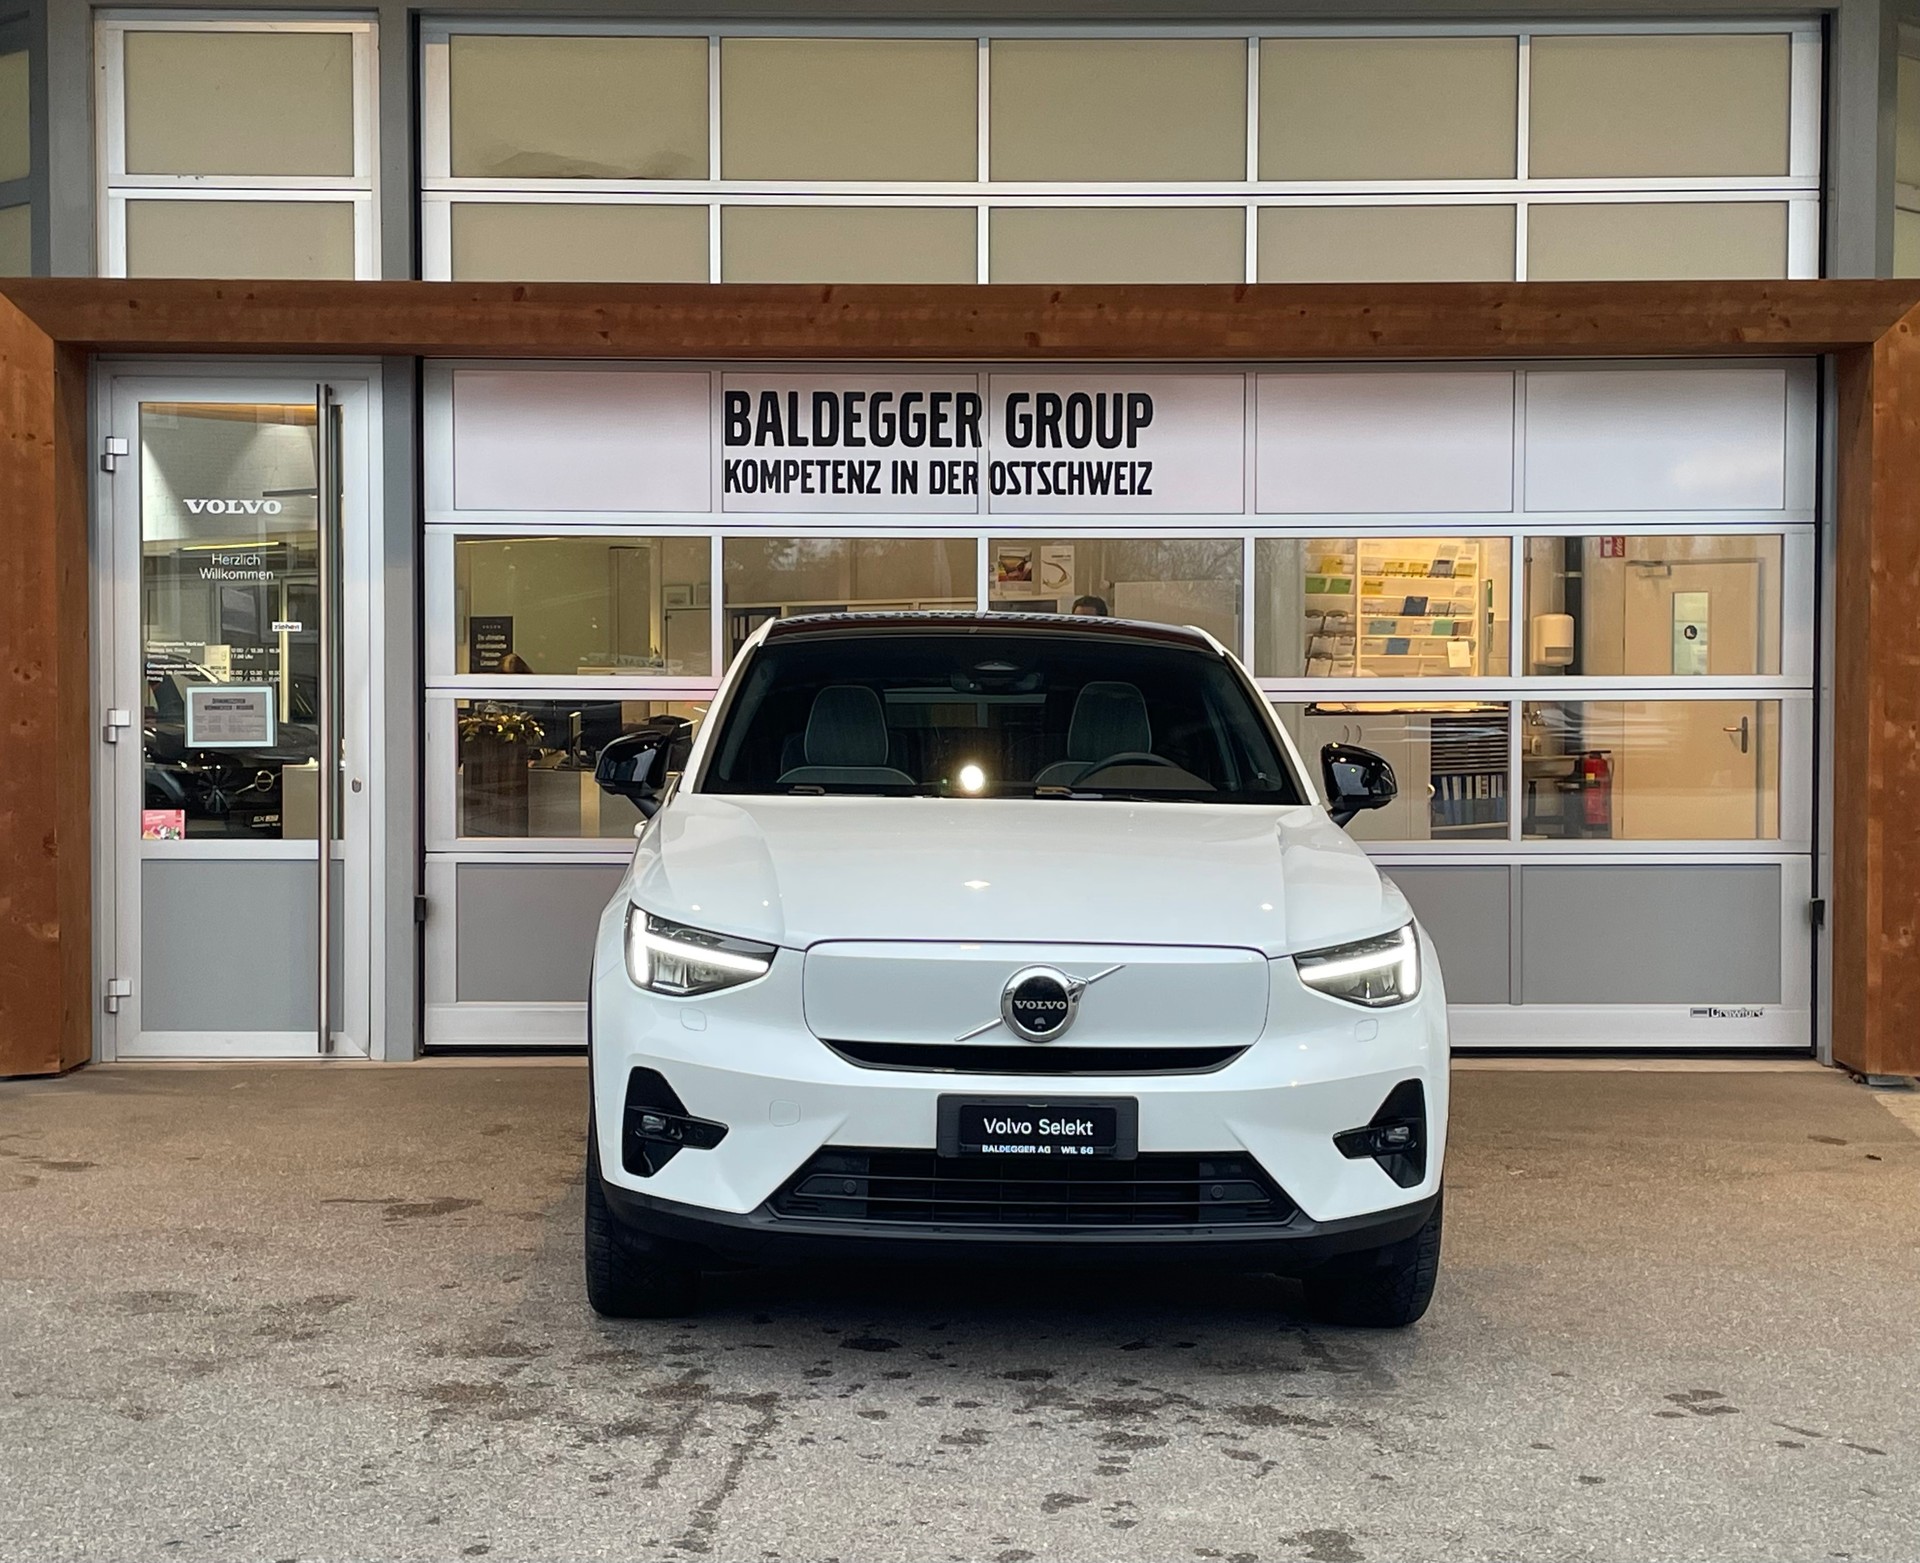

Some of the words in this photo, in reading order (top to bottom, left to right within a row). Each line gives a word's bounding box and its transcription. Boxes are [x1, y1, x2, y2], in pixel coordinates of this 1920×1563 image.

[724, 391, 982, 448] BALDEGGER
[1005, 392, 1153, 449] GROUP
[724, 459, 881, 495] KOMPETENZ
[892, 460, 918, 495] IN
[929, 460, 978, 495] DER
[989, 461, 1153, 496] OSTSCHWEIZ
[183, 499, 282, 514] VOLVO
[211, 553, 260, 565] Herzlich
[199, 567, 274, 580] Willkommen
[1014, 1000, 1067, 1010] VOLVO
[983, 1117, 1033, 1135] Volvo
[1038, 1118, 1094, 1136] Selekt
[982, 1144, 1036, 1154] BALDEGGER
[1037, 1145, 1052, 1154] AG
[1060, 1146, 1078, 1155] WIL
